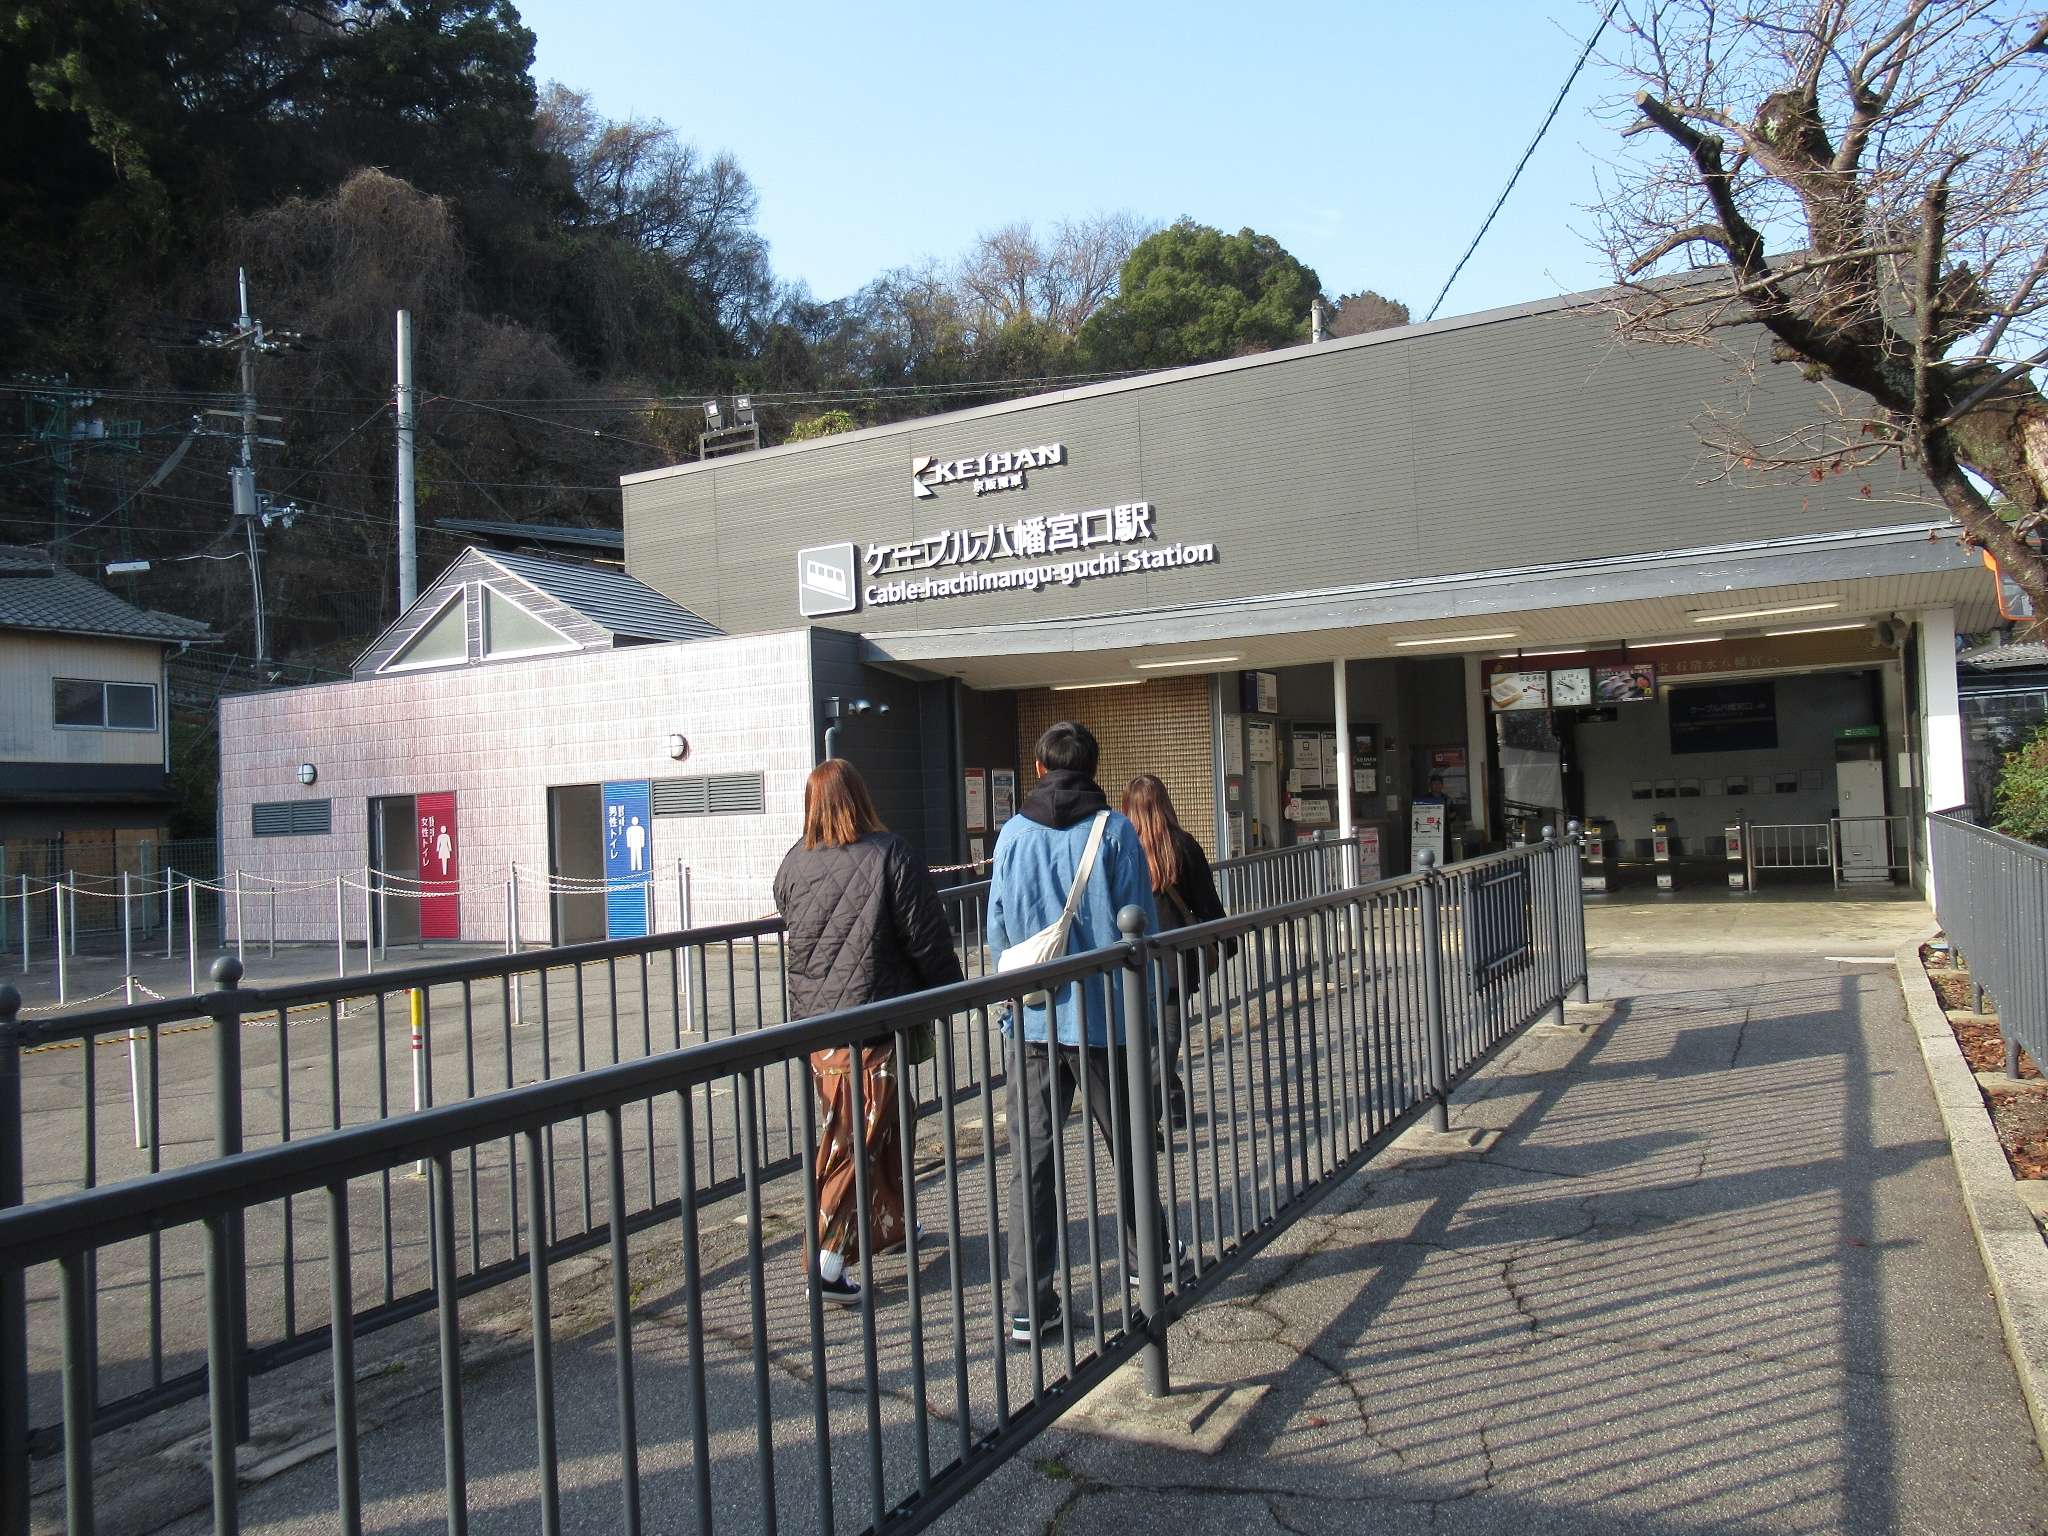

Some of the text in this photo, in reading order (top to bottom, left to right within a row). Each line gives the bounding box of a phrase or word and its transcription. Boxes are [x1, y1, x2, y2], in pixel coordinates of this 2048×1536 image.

[933, 444, 1062, 483] KEIHAN
[863, 502, 1152, 576] ケーブル八幡宮口駅
[864, 543, 1213, 605] Cable-hachimangu-guchi Station
[421, 816, 430, 867] 女性トイレ
[608, 805, 618, 860] 男性トイレ
